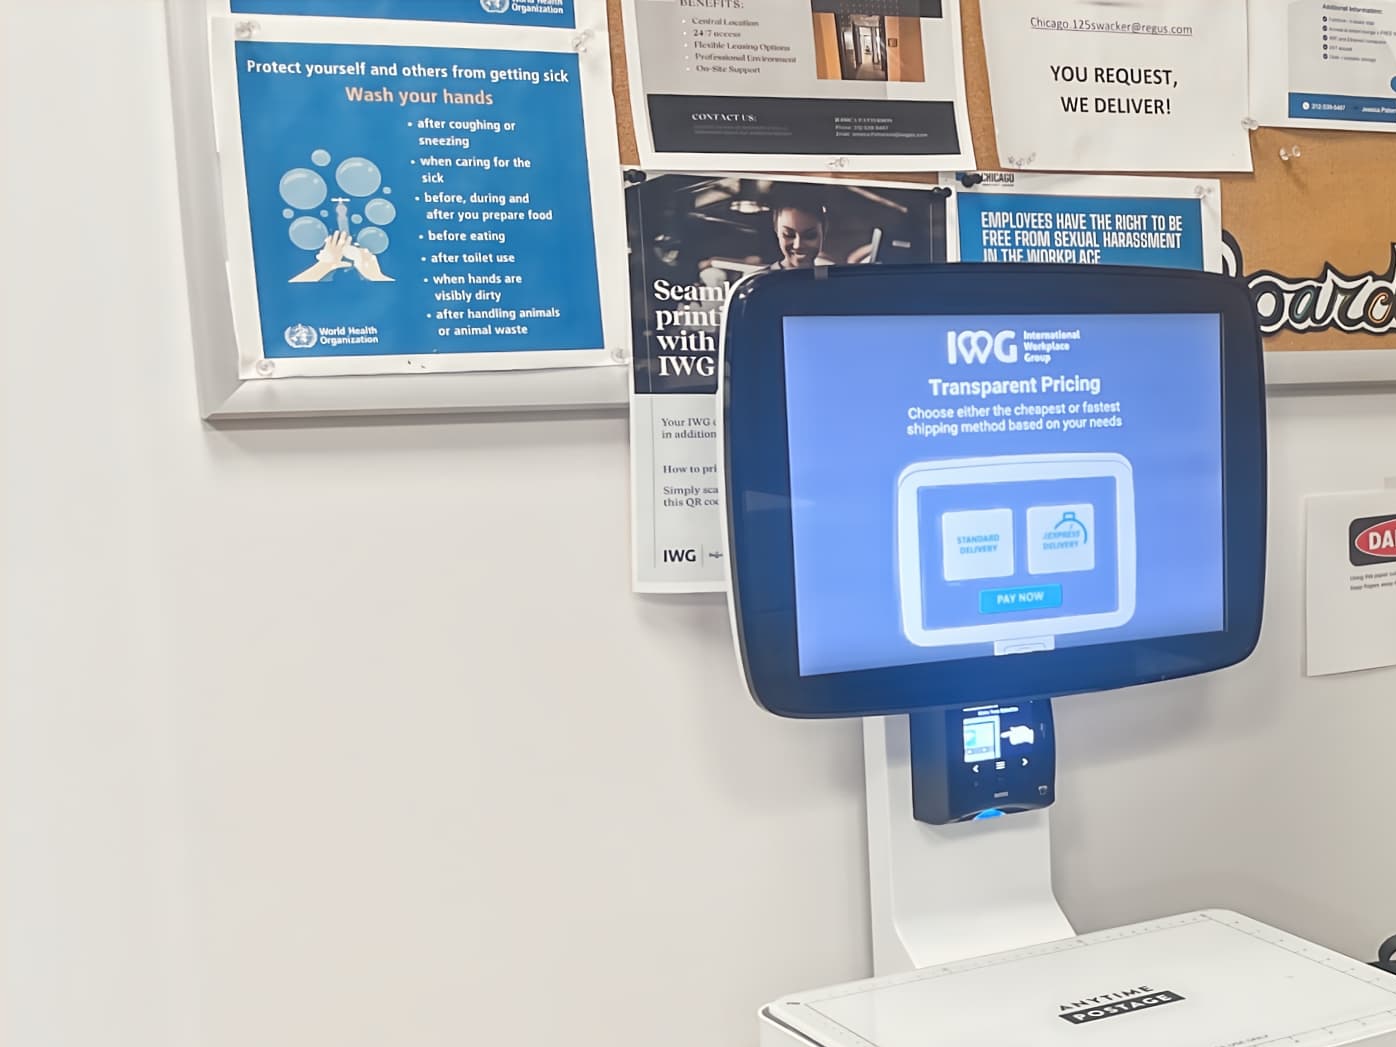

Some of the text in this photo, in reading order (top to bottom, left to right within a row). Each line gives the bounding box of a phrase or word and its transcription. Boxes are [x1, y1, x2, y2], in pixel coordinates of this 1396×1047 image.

[511, 3, 564, 14] Organization
[247, 60, 569, 84] Protect yourself and others from getting sick
[728, 66, 761, 74] Support
[1050, 65, 1178, 89] YOU REQUEST,
[345, 86, 494, 107] Wash your hands
[1060, 96, 1172, 115] WE DELIVER!
[691, 113, 740, 121] CONTACT
[417, 118, 516, 132] after coughing or
[419, 136, 470, 149] sneezing
[420, 156, 531, 169] when caring for the
[421, 172, 444, 183] sick
[982, 173, 1015, 183] CHICAGO
[424, 192, 529, 206] before, during and
[426, 209, 553, 222] after you prepare food
[981, 211, 1183, 232] EMPLOYEES HAVE THE RIGHT TO BE
[428, 230, 505, 243] before eating
[982, 230, 1182, 249] FREE FROM SEXUAL HARASSMENT
[431, 252, 516, 263] after toilet use
[983, 248, 1101, 264] IN THE WORKPLACE
[433, 273, 522, 284] when hands are
[435, 290, 501, 303] visibly dirty
[653, 279, 730, 301] Seaml
[436, 307, 560, 320] after handling animals
[655, 305, 723, 330] print
[319, 326, 378, 335] World Health
[438, 325, 528, 336] or animal waste
[1023, 330, 1081, 341] International
[319, 335, 379, 346] Organization
[656, 330, 715, 351] with
[1023, 341, 1070, 352] Workplace
[947, 330, 1018, 365] IWG
[1023, 353, 1052, 364] Group
[658, 355, 714, 377] IWG
[928, 375, 1101, 399] Transparent Pricing
[908, 401, 1121, 420] Choose either the cheapest or fastest
[661, 418, 685, 427] Your
[688, 418, 711, 427] IWG
[906, 415, 1122, 437] shipping method based on your needs
[662, 430, 717, 439] in addition
[663, 465, 688, 473] How
[702, 465, 717, 475] pri
[663, 486, 700, 496] Simply
[663, 498, 702, 508] this QR
[663, 549, 696, 562] IWG
[996, 591, 1045, 605] PAY NOW
[1060, 985, 1154, 1011] ANYTIME
[1072, 994, 1173, 1021] POSTAGE
